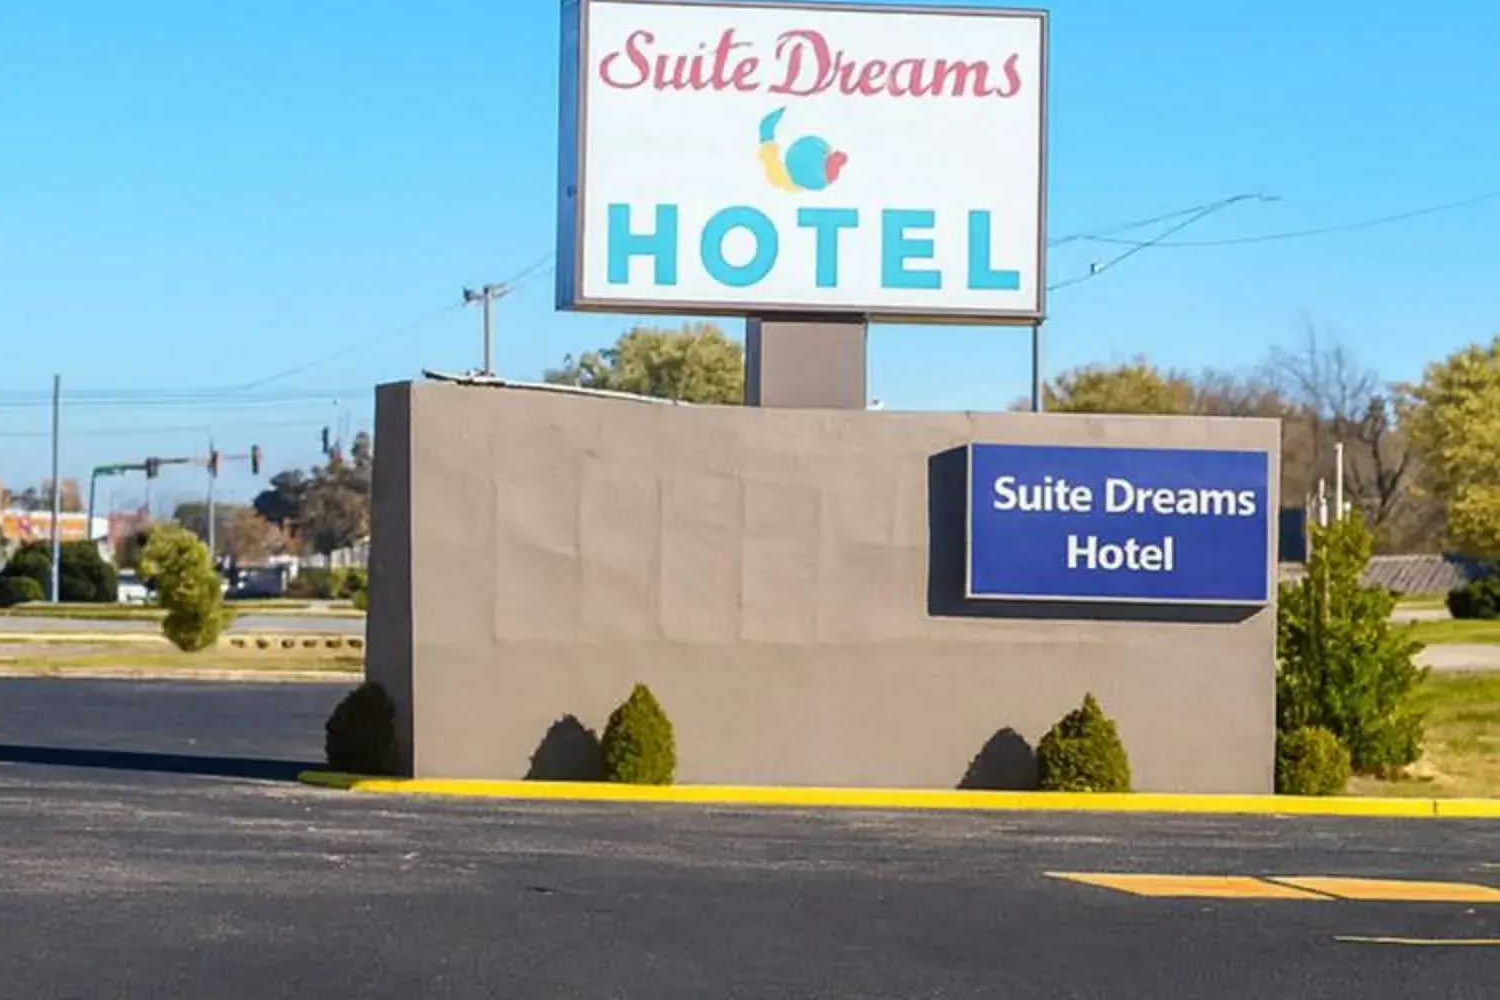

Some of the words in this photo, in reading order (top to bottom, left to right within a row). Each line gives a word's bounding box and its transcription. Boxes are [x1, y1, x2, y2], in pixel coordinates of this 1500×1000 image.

[600, 28, 760, 91] Suite
[769, 29, 1022, 97] Dreams
[607, 203, 1021, 290] HOTEL
[993, 475, 1092, 511] Suite
[1105, 477, 1256, 516] Dreams
[1067, 535, 1173, 571] Hotel
